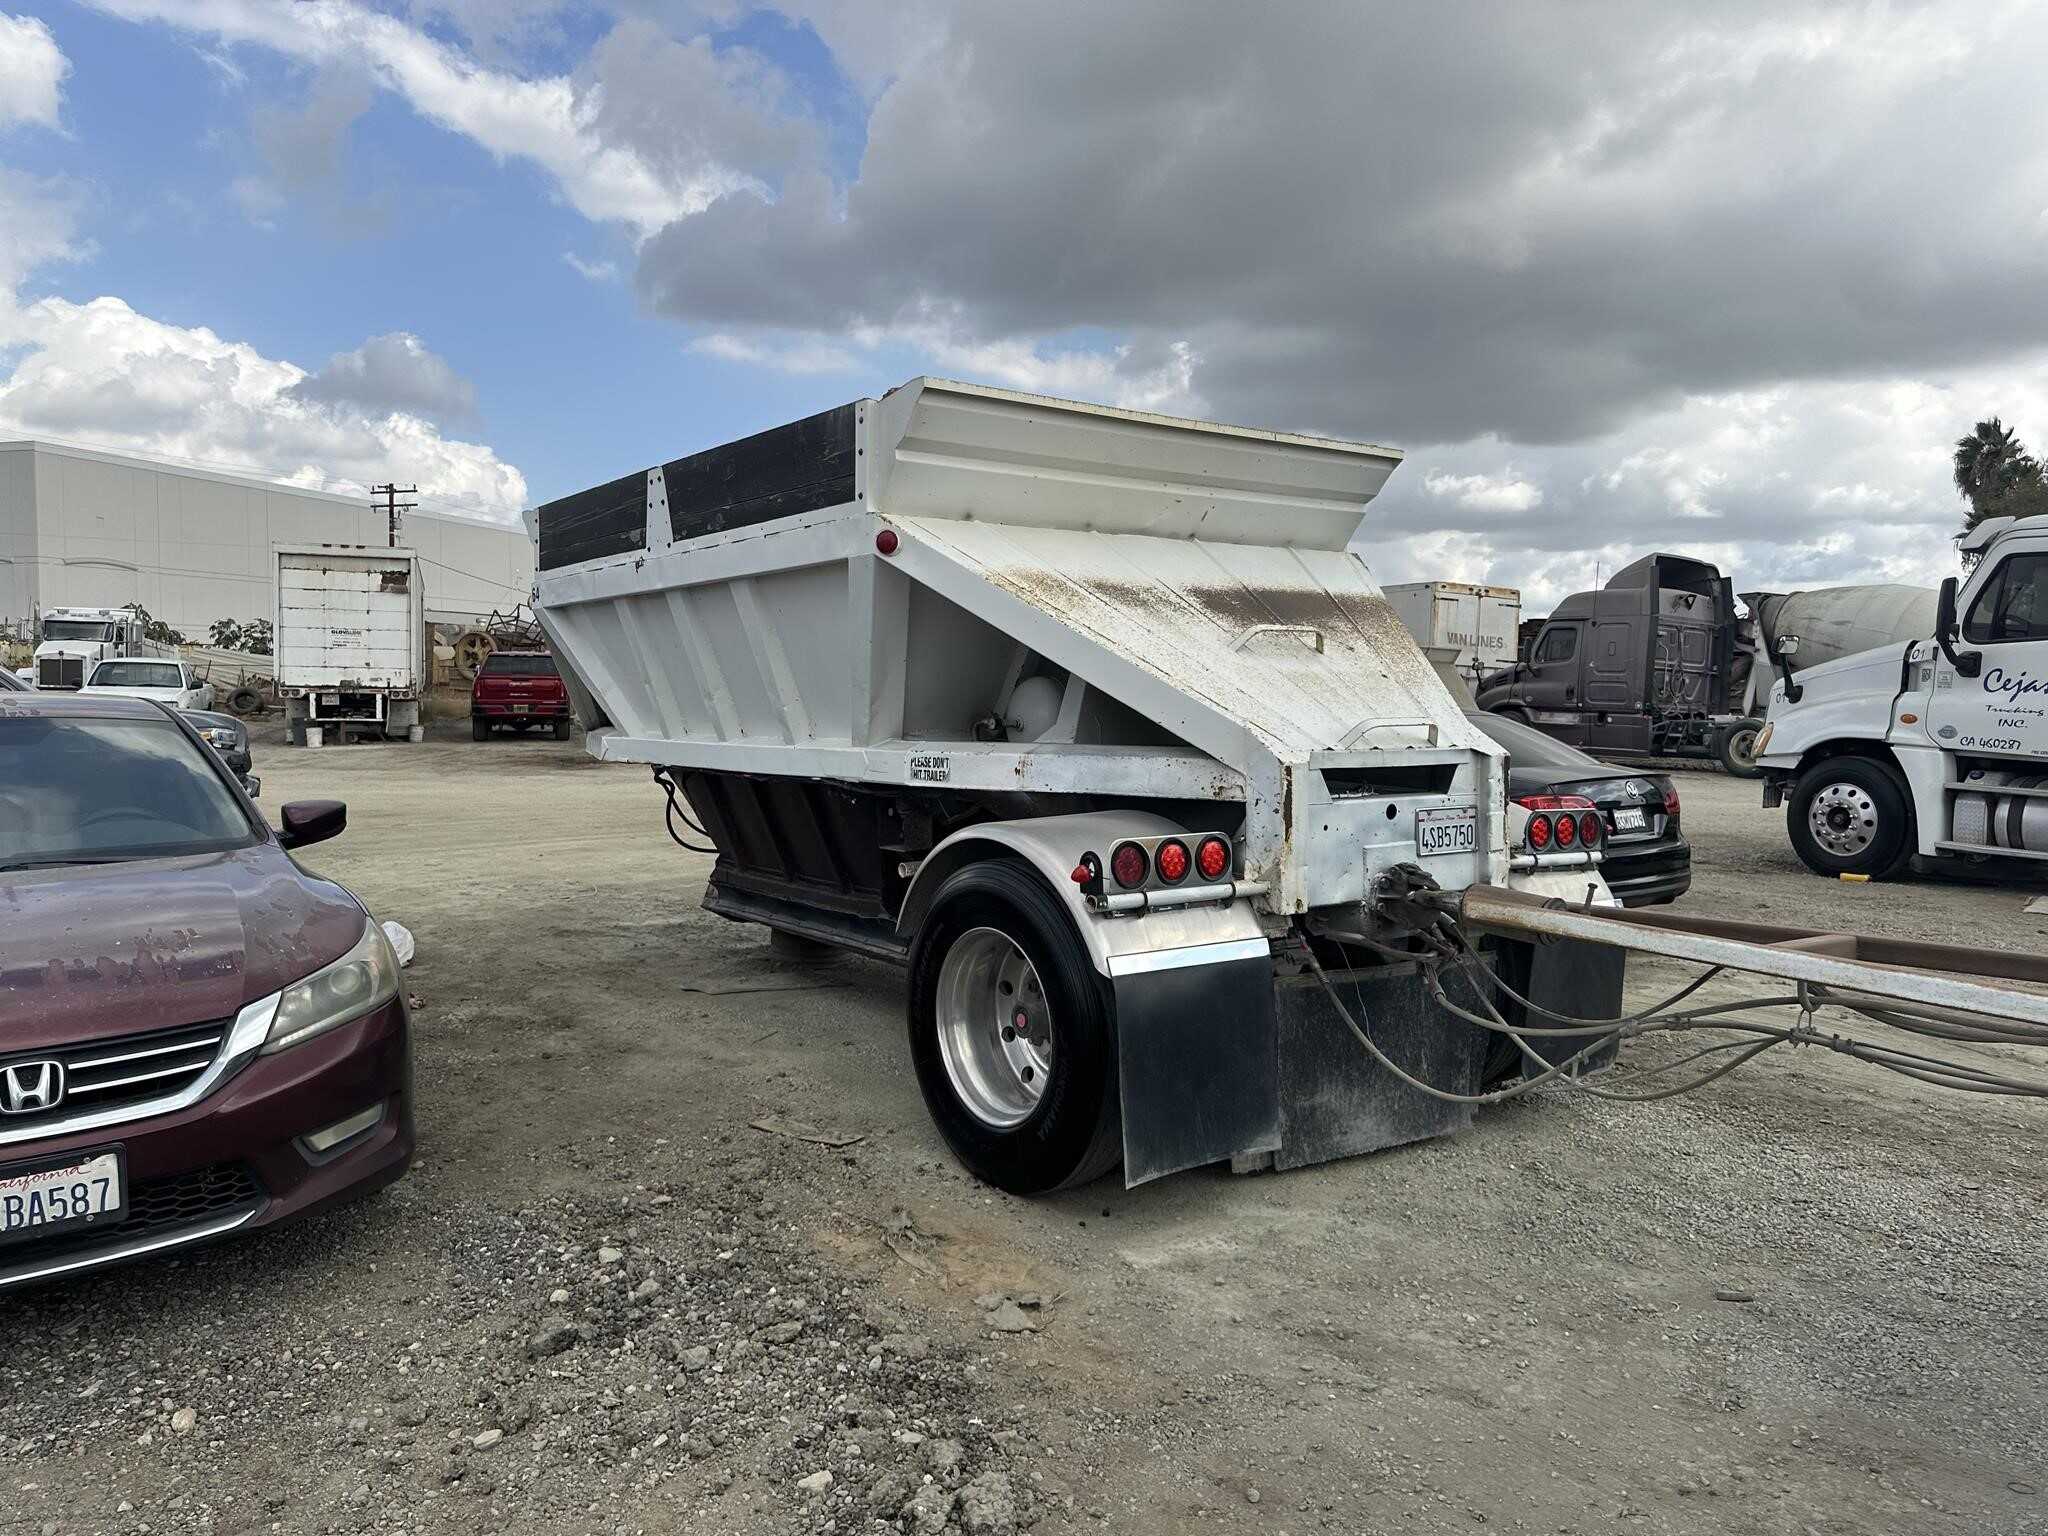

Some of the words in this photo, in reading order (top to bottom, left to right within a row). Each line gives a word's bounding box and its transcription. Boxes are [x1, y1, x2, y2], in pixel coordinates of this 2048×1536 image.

[1448, 632, 1467, 647] VAN
[1469, 635, 1503, 649] LINES
[1986, 705, 2044, 717] Trucking
[1998, 719, 2028, 729] INC.
[1960, 736, 1975, 746] CA
[1980, 738, 2021, 750] 460287
[911, 757, 931, 768] PLEASE
[914, 770, 922, 779] HIT
[1422, 823, 1474, 849] 4SB5750
